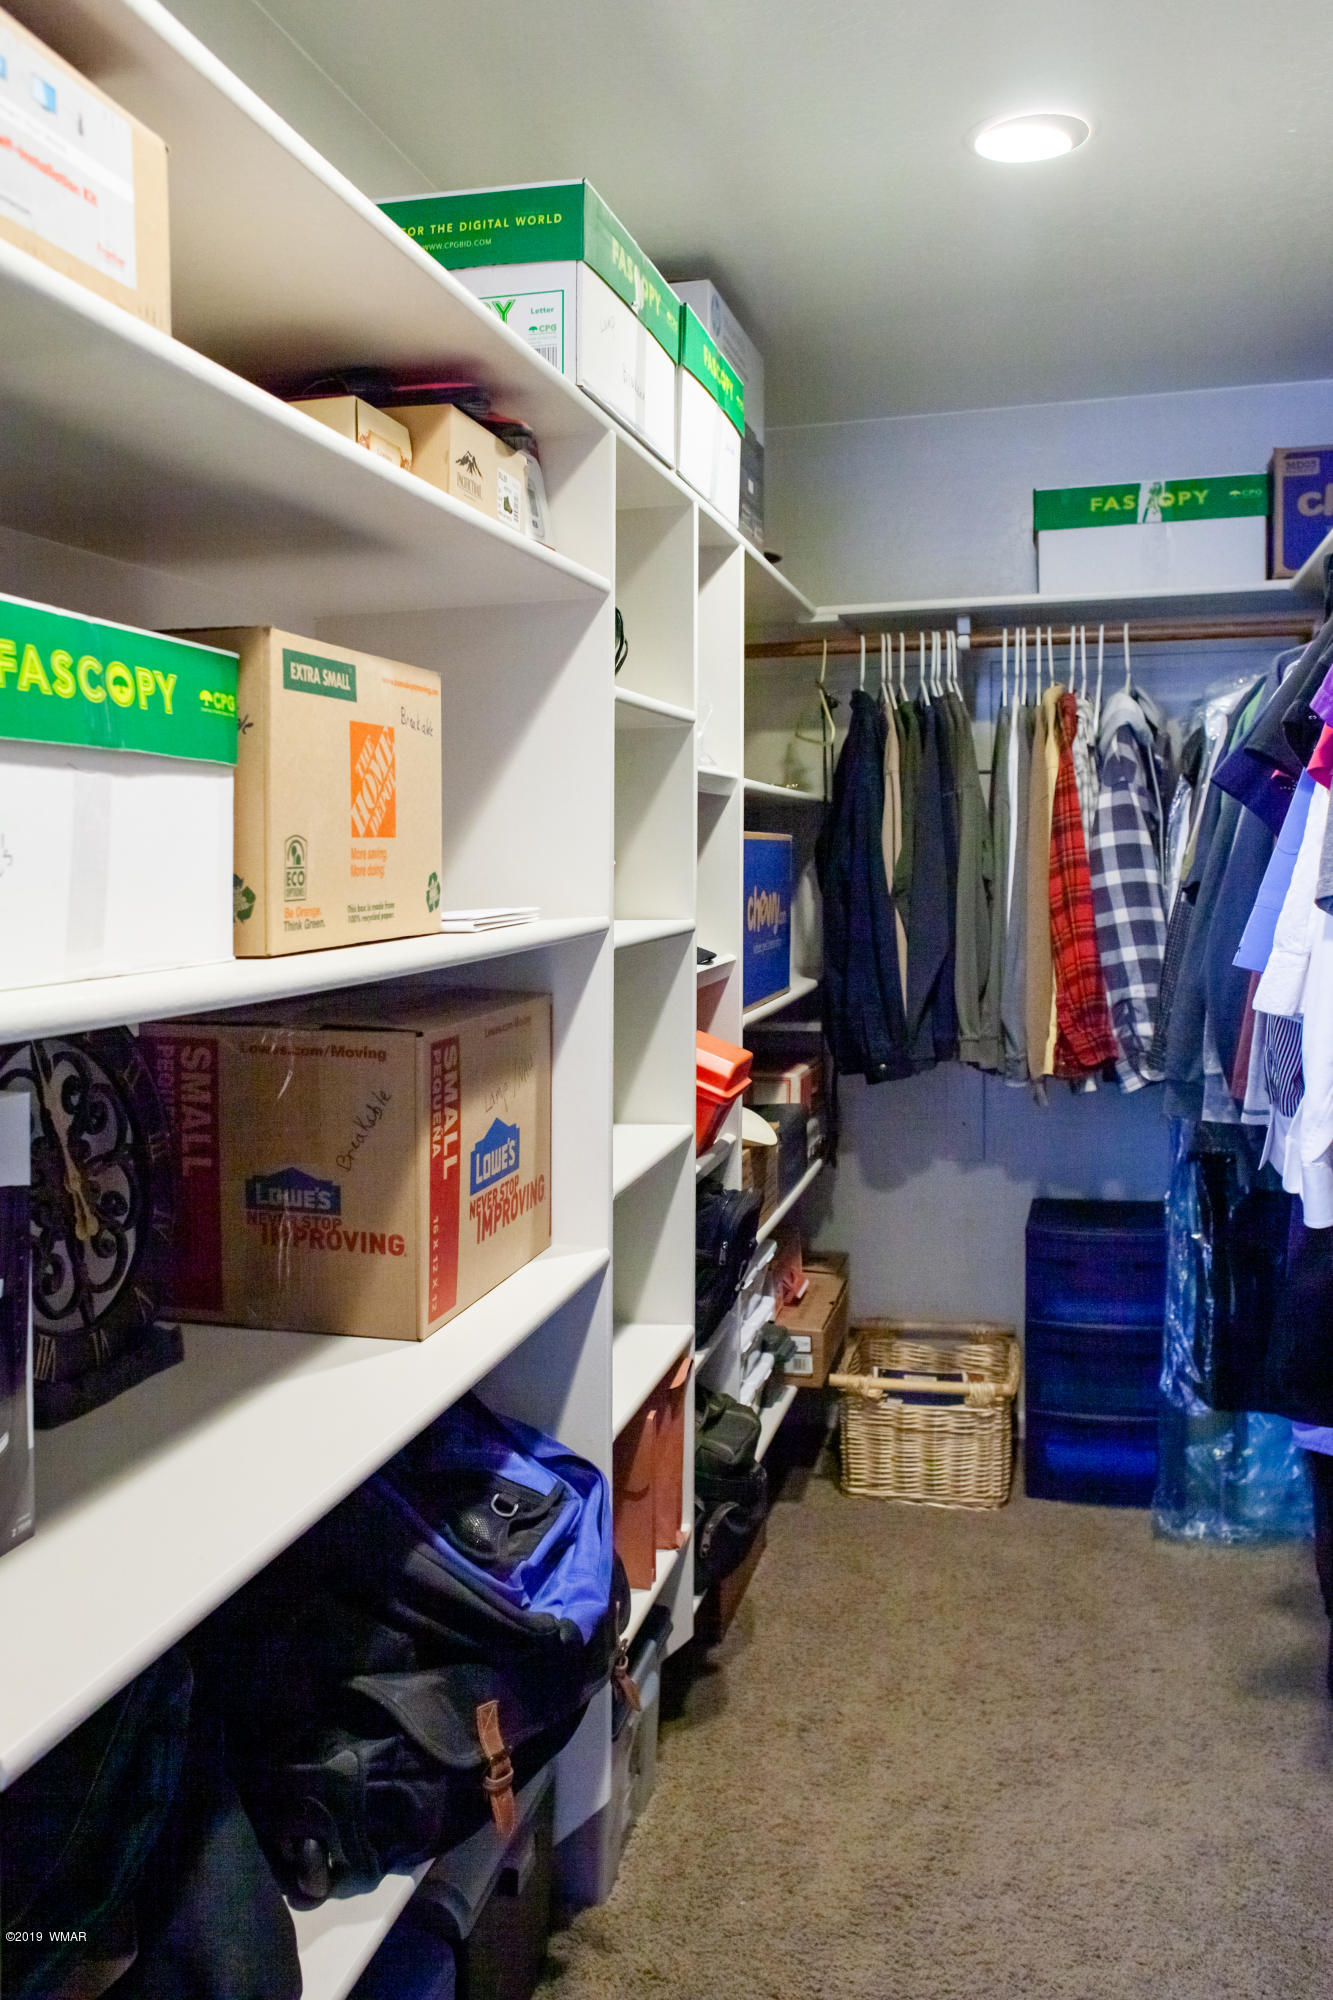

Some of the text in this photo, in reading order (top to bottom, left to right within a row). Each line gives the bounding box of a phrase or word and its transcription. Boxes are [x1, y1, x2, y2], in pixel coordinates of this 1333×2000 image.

[430, 223, 453, 234] THE
[459, 217, 510, 232] DIGITAL
[515, 213, 563, 227] WORLD
[530, 307, 554, 315] Letter
[539, 323, 557, 332] CPG
[0, 637, 177, 715] FASCOPY
[290, 661, 351, 691] EXTRA SMALL
[213, 691, 235, 712] CPG
[351, 726, 395, 838] HOME
[286, 870, 305, 887] ECO
[283, 906, 294, 919] Be
[283, 919, 302, 932] Think
[181, 1046, 212, 1177] SMALL
[432, 1049, 445, 1160] PEQUEÑA
[443, 1044, 459, 1180] SMALL
[336, 1089, 392, 1172] Breakable
[475, 1137, 516, 1185] LOWE'S
[256, 1182, 332, 1210] LOWE'S
[469, 1174, 519, 1221] NEVER STOP
[477, 1174, 545, 1245] IMPROVING
[302, 1215, 343, 1231] STOP
[431, 1216, 440, 1235] 16
[431, 1254, 440, 1274] 12
[431, 1293, 440, 1313] 12
